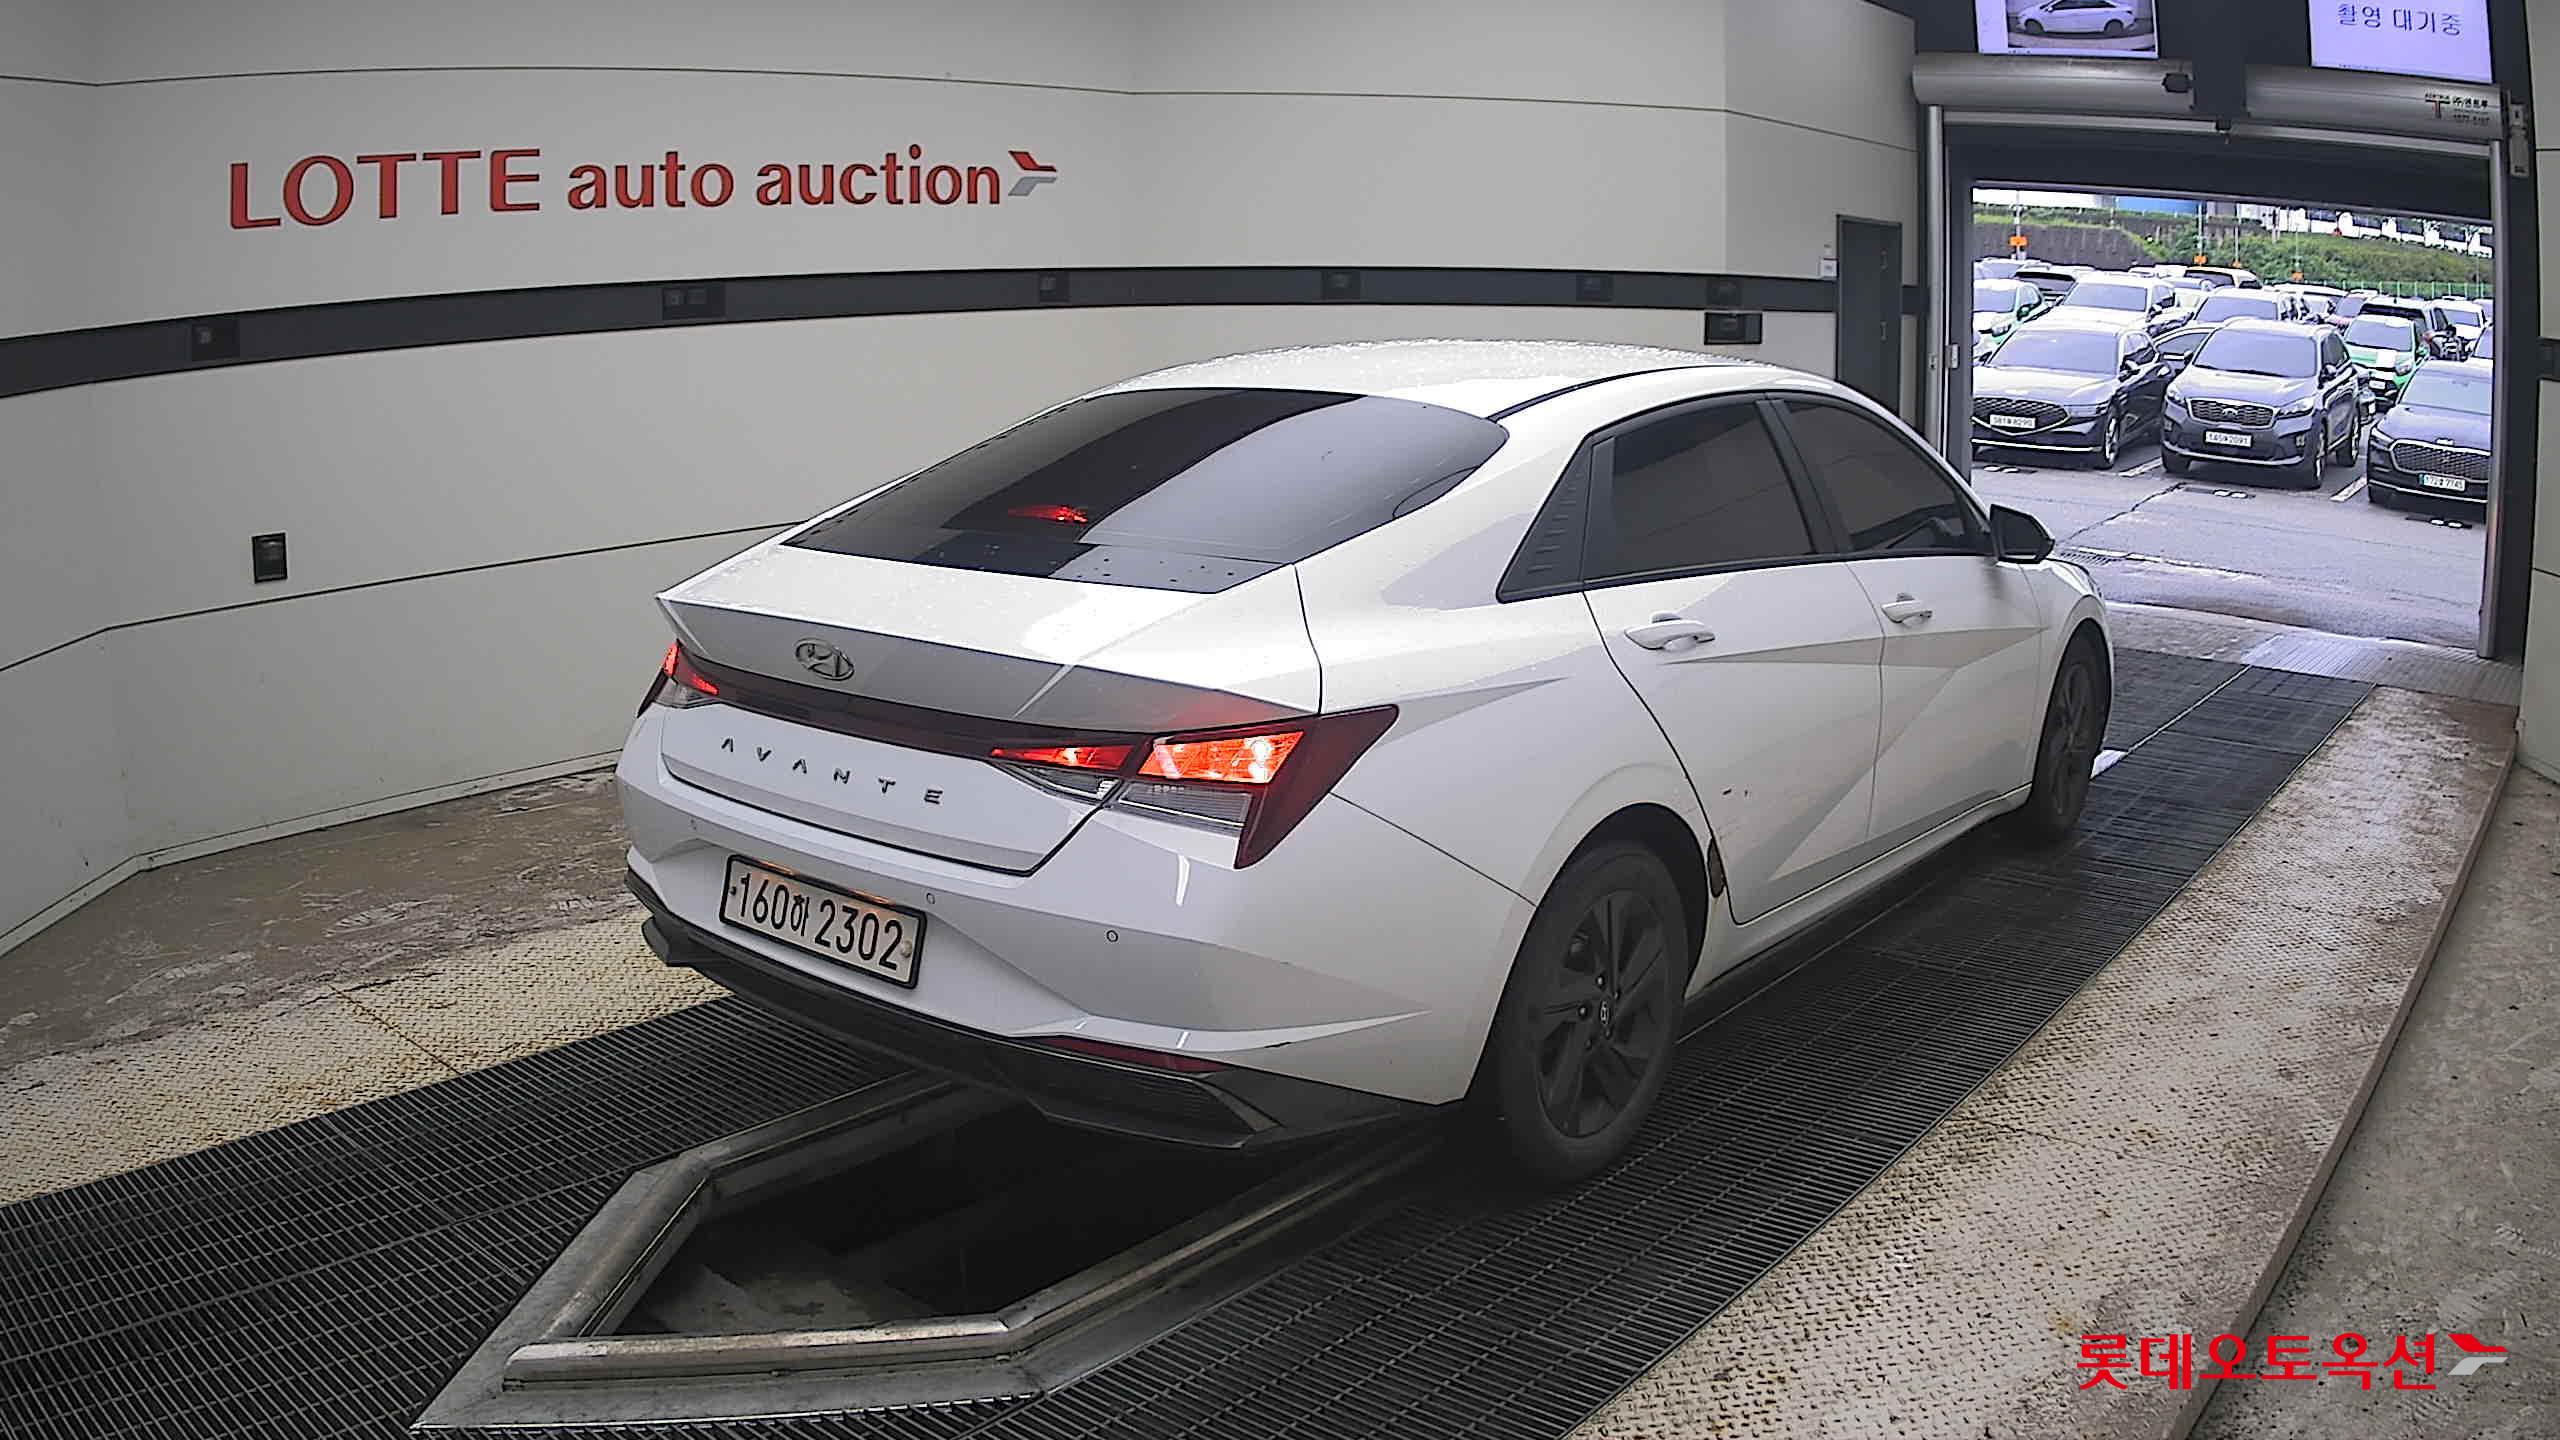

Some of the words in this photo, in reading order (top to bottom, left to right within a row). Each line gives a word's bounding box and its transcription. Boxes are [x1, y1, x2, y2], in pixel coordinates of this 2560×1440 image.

[2337, 3, 2382, 28] 촬영
[2392, 8, 2461, 36] 대기중
[230, 148, 540, 230] LOTTE
[567, 150, 735, 211] auto
[756, 144, 1002, 206] auction
[721, 736, 943, 805] AVANTE
[740, 872, 810, 937] 160하
[814, 899, 904, 971] 2302
